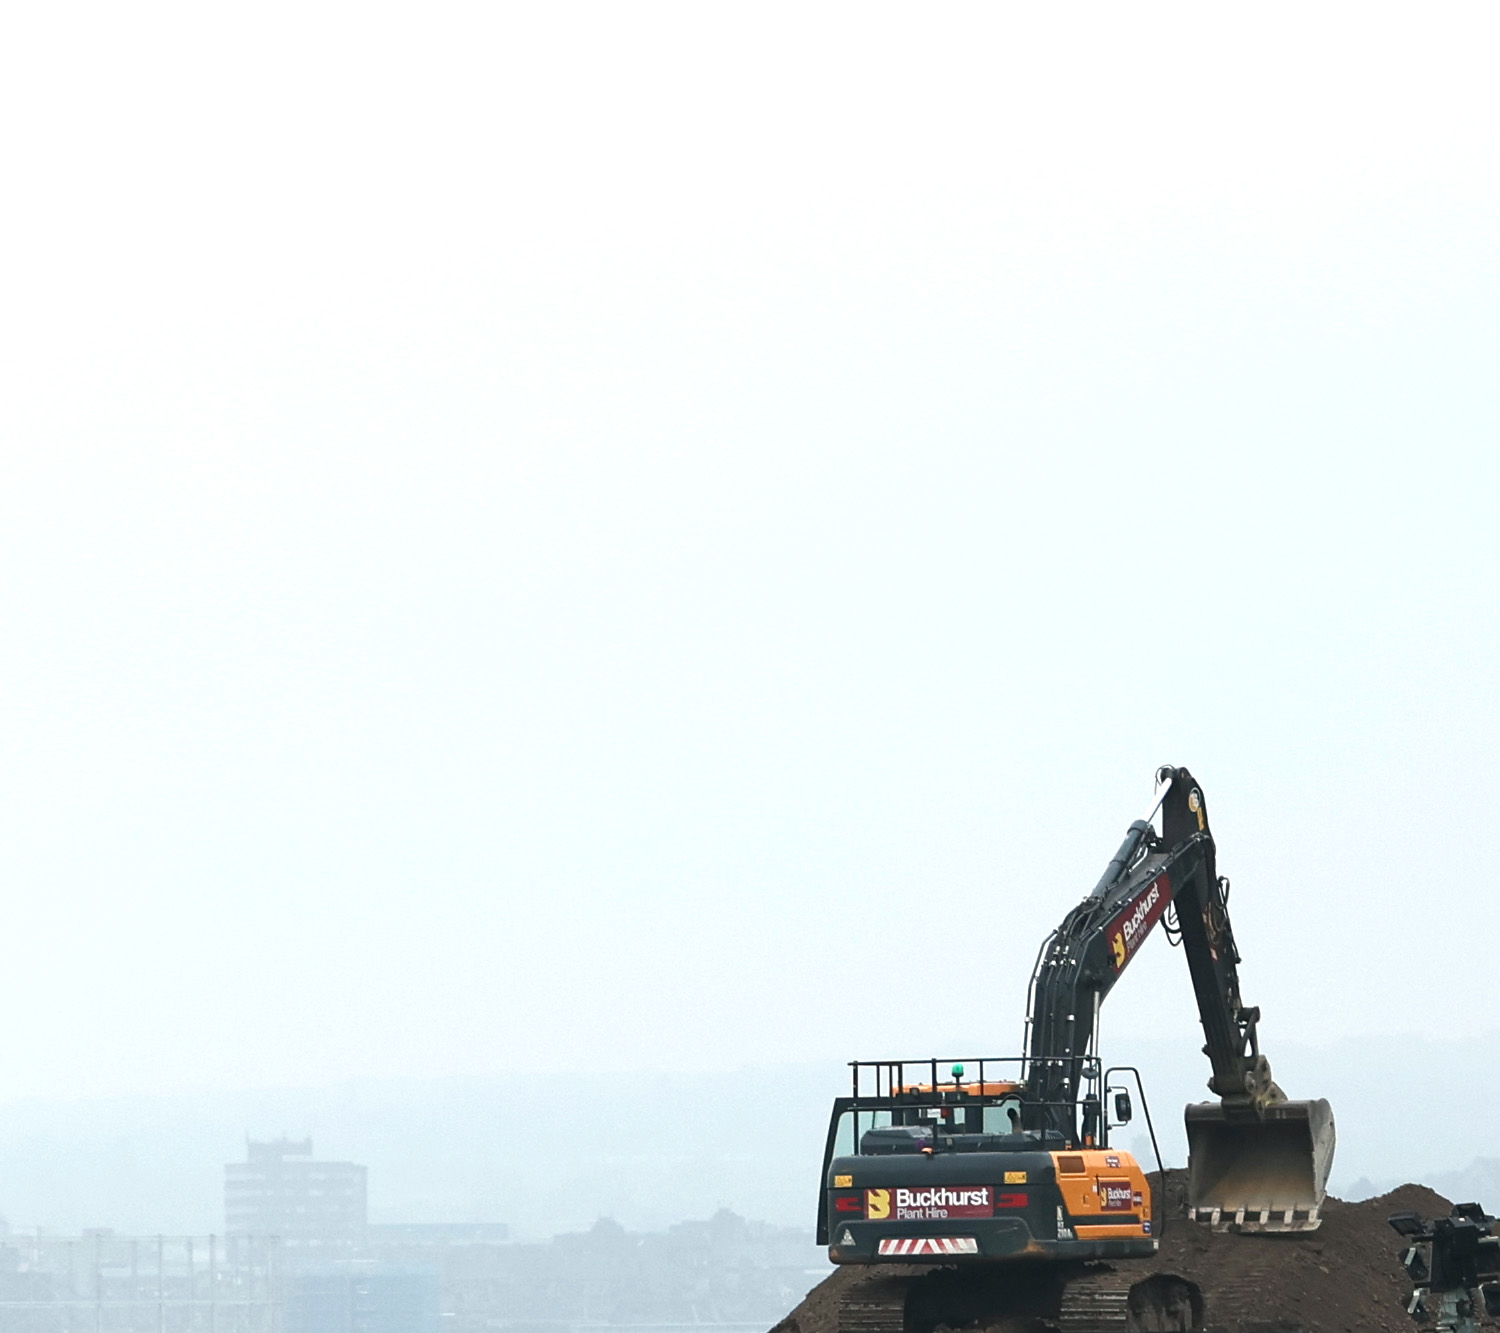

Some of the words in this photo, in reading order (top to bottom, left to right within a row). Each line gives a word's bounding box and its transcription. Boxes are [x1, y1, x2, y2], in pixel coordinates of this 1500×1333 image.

[896, 1187, 989, 1208] Buckhurst
[896, 1207, 924, 1220] Plant
[925, 1206, 948, 1219] Hire
